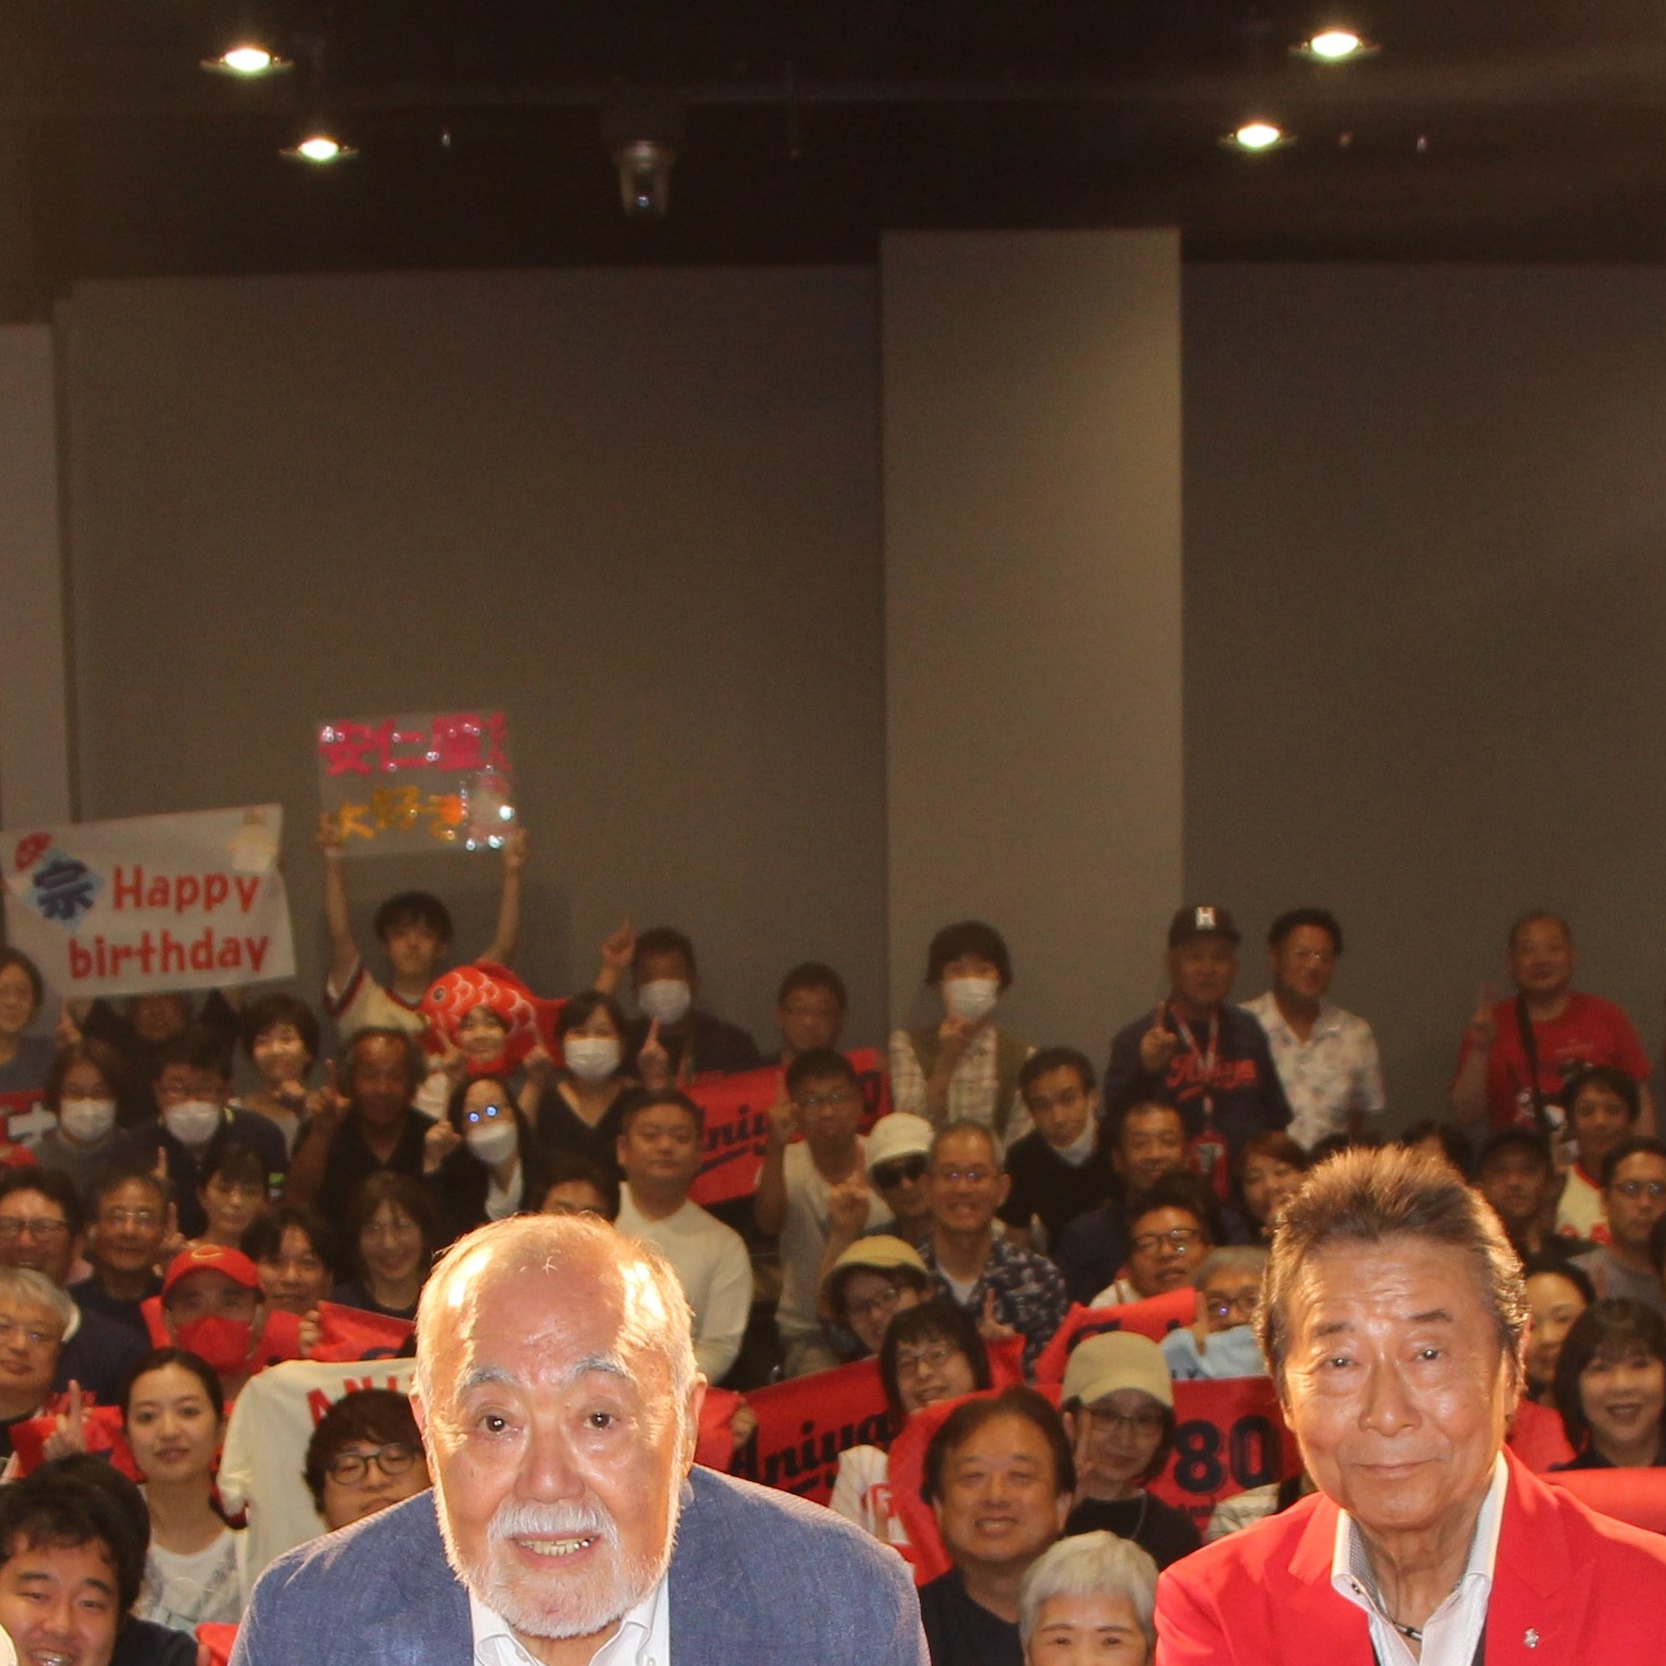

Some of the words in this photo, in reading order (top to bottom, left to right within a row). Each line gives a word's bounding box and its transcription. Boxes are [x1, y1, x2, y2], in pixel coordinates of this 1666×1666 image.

[112, 863, 261, 914] Happy
[1195, 905, 1217, 931] H
[67, 926, 270, 981] birthday
[1173, 1413, 1282, 1494] 80
